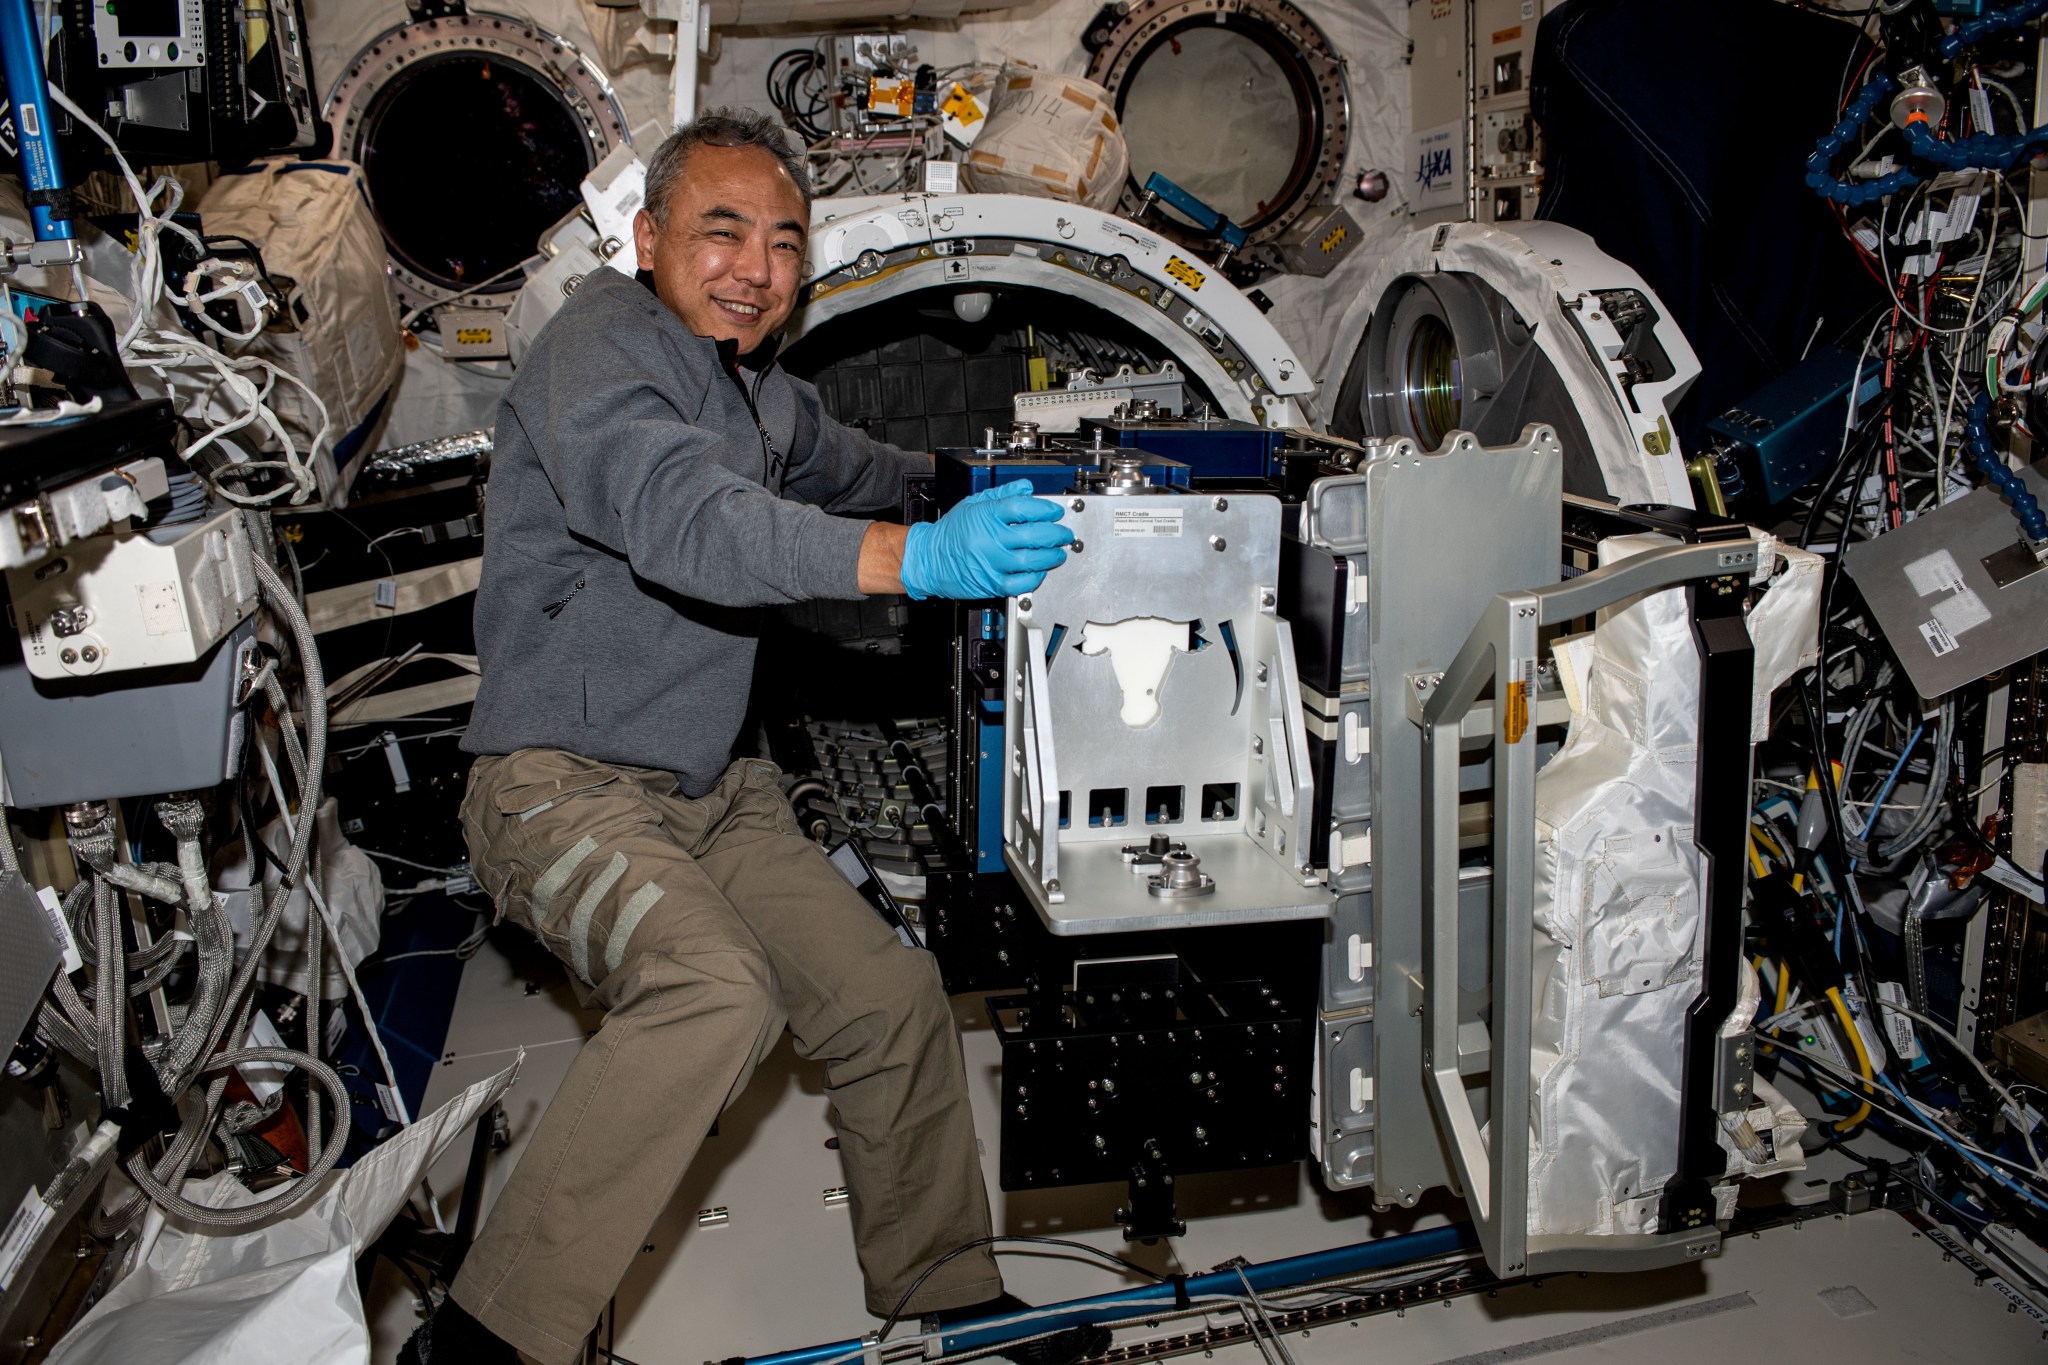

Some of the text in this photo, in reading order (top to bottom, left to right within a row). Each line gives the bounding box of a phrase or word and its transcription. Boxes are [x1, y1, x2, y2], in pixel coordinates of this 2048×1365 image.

[1415, 148, 1452, 194] JAXA
[1930, 1229, 1982, 1269] JPM1 D6
[1993, 1282, 2043, 1319] ECLSS/TCS
